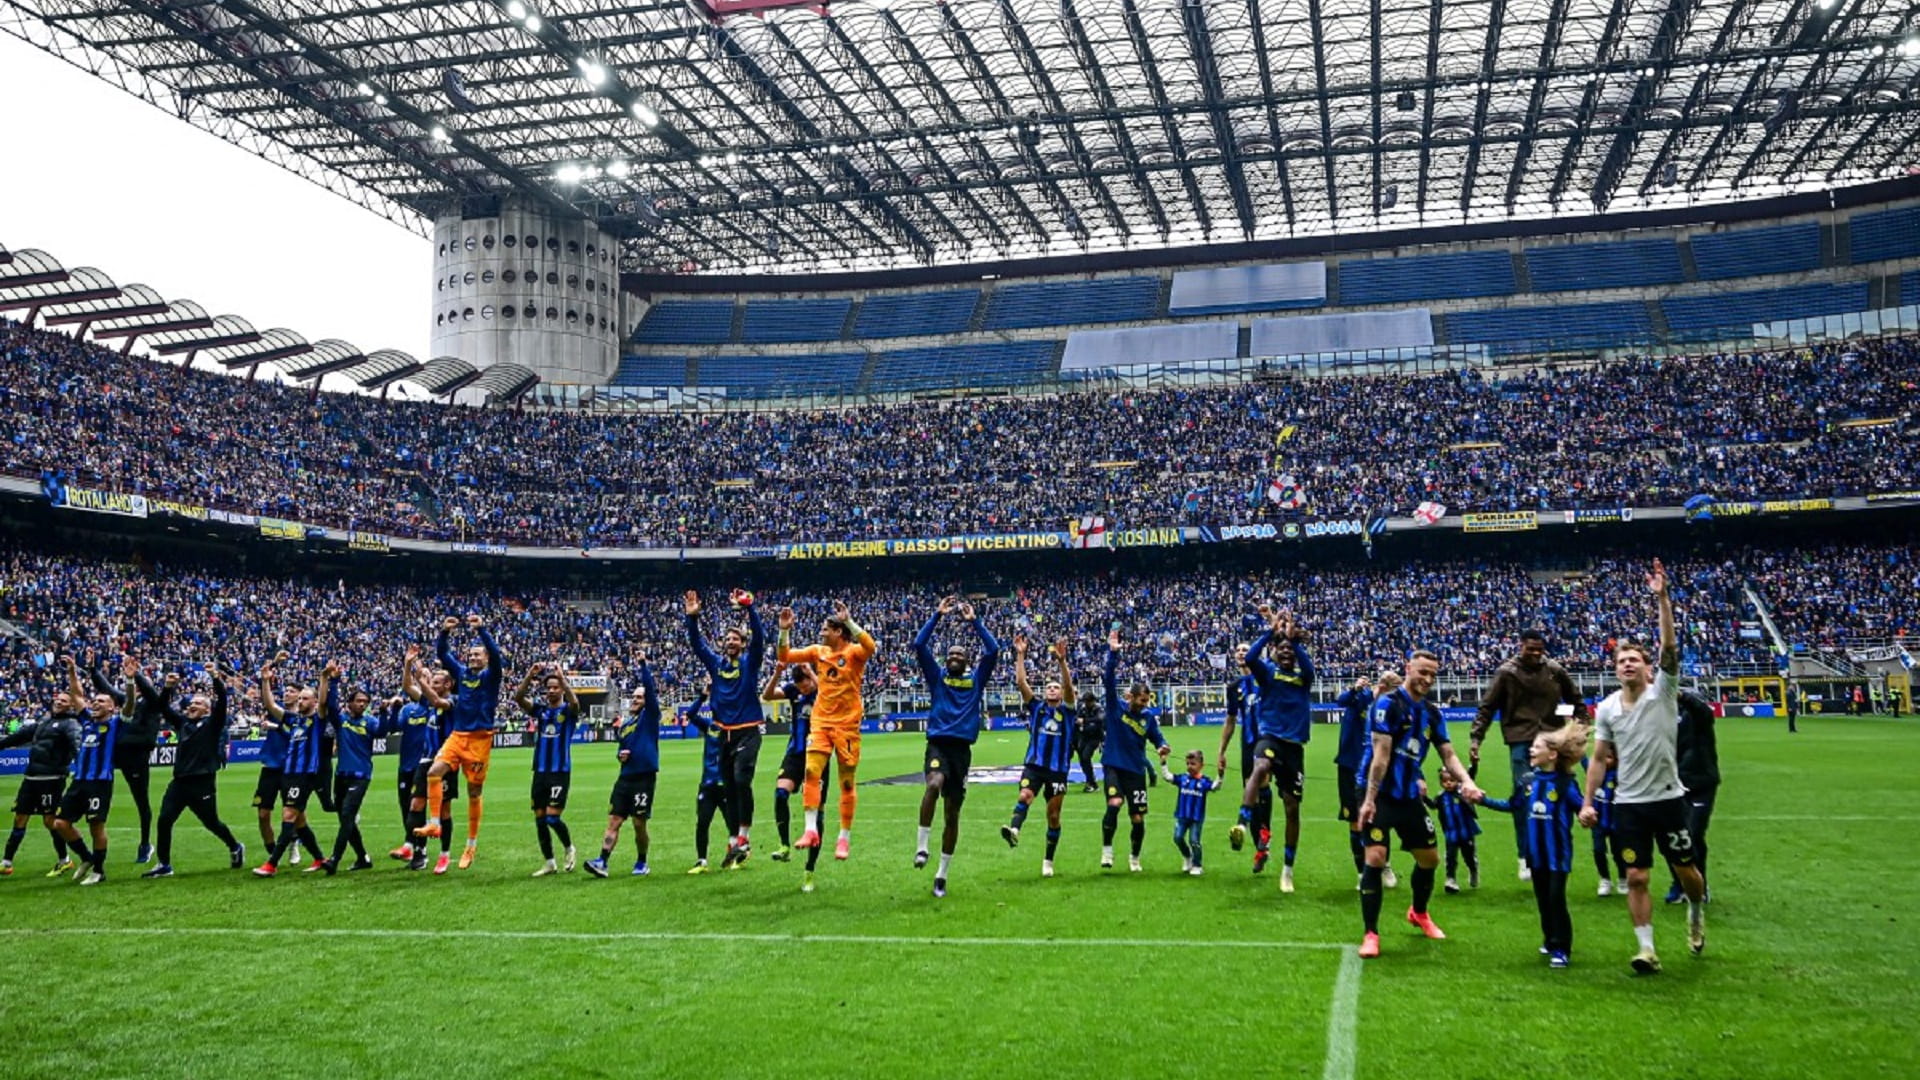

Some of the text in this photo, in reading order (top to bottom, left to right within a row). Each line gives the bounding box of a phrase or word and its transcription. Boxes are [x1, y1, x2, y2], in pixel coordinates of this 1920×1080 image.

[69, 486, 133, 512] ROTALIANO
[788, 544, 823, 559] ALTO
[825, 540, 886, 557] POLESINE
[893, 534, 1059, 555] BASSO VICENTINO
[550, 785, 563, 799] 17
[634, 792, 649, 807] 52
[1133, 790, 1148, 805] 22
[41, 793, 53, 807] 21
[88, 796, 101, 811] 10
[1424, 815, 1435, 833] 8
